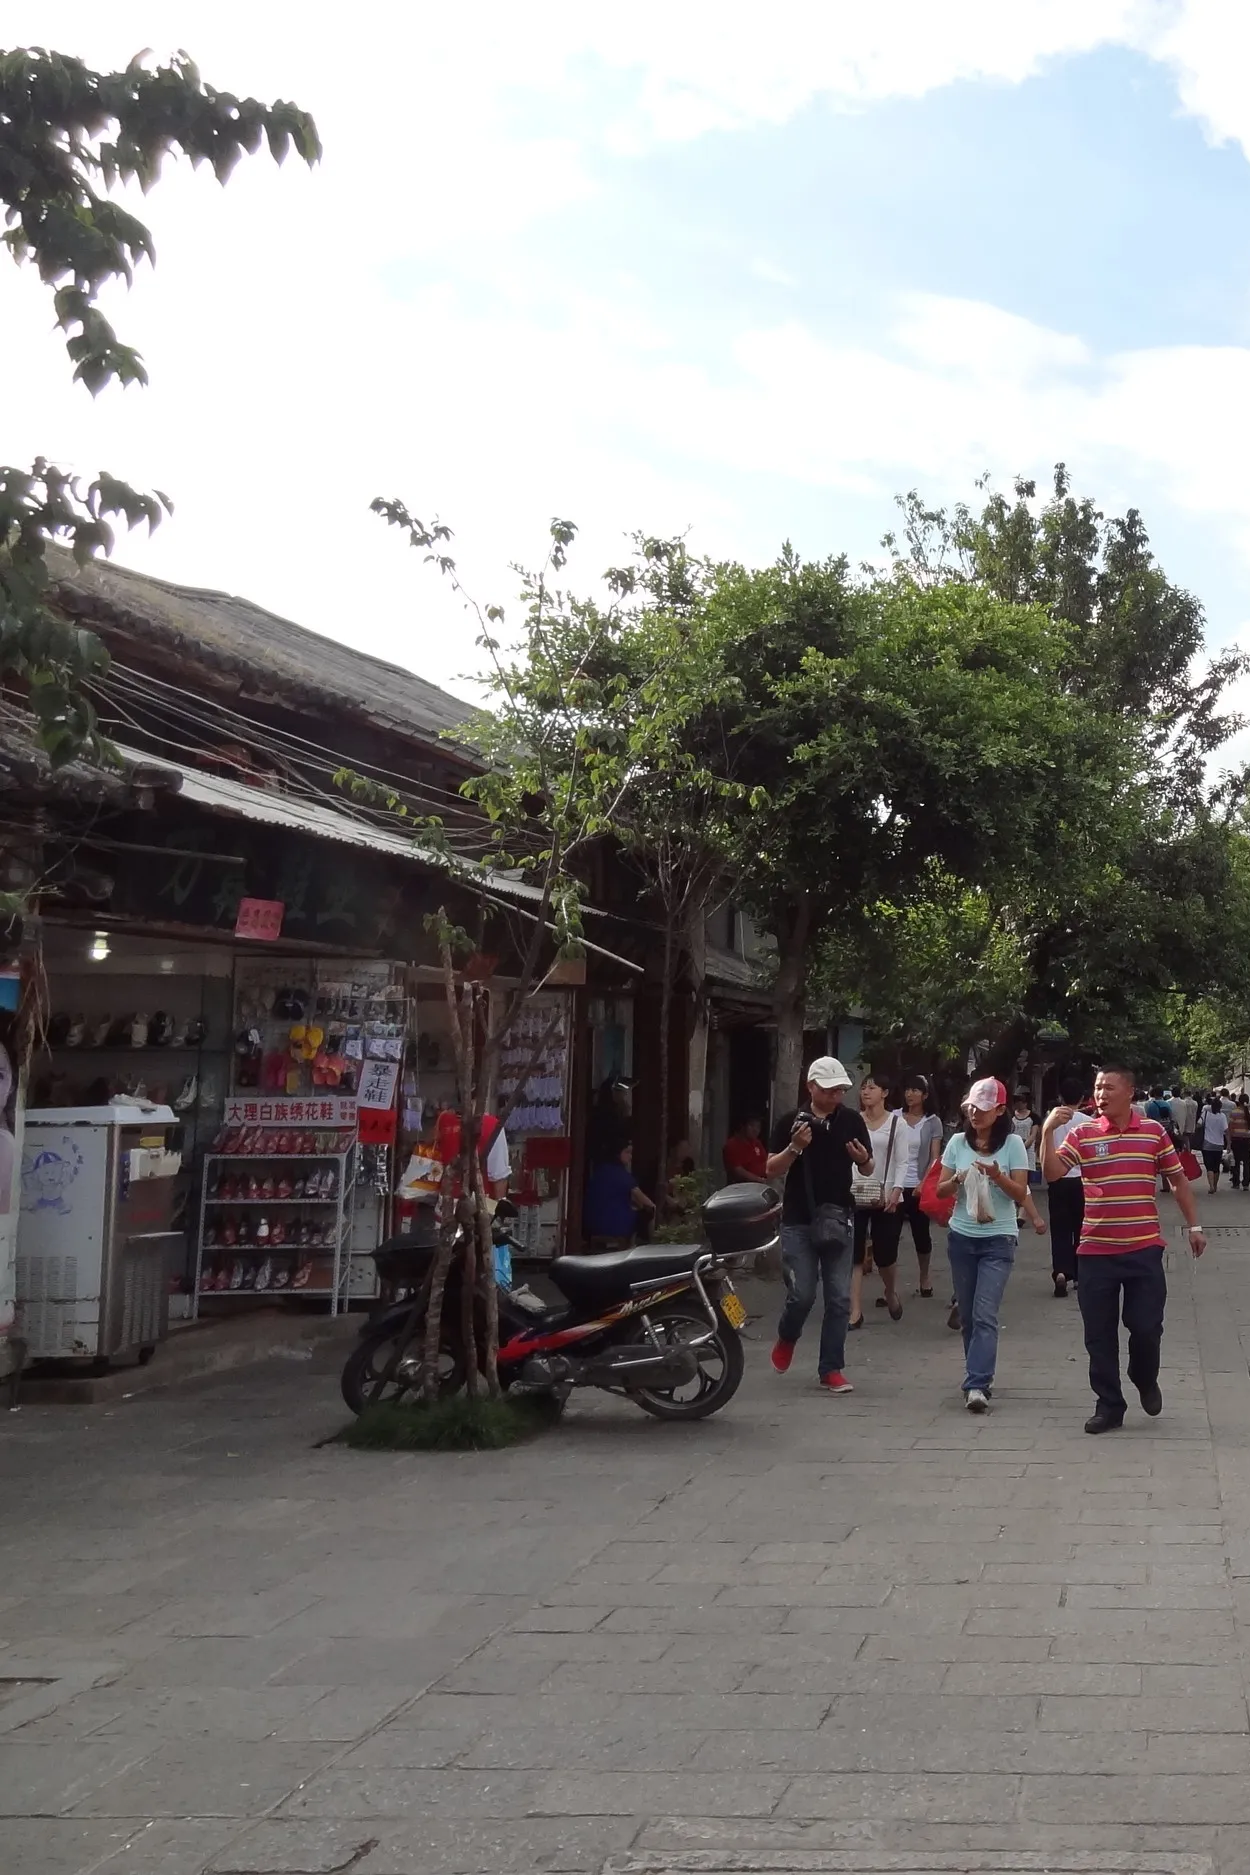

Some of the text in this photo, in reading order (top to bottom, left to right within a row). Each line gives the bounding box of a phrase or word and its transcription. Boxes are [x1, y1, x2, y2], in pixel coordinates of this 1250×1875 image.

[364, 1063, 392, 1104] 暴走鞋
[228, 1102, 334, 1122] 大理白族绣花鞋
